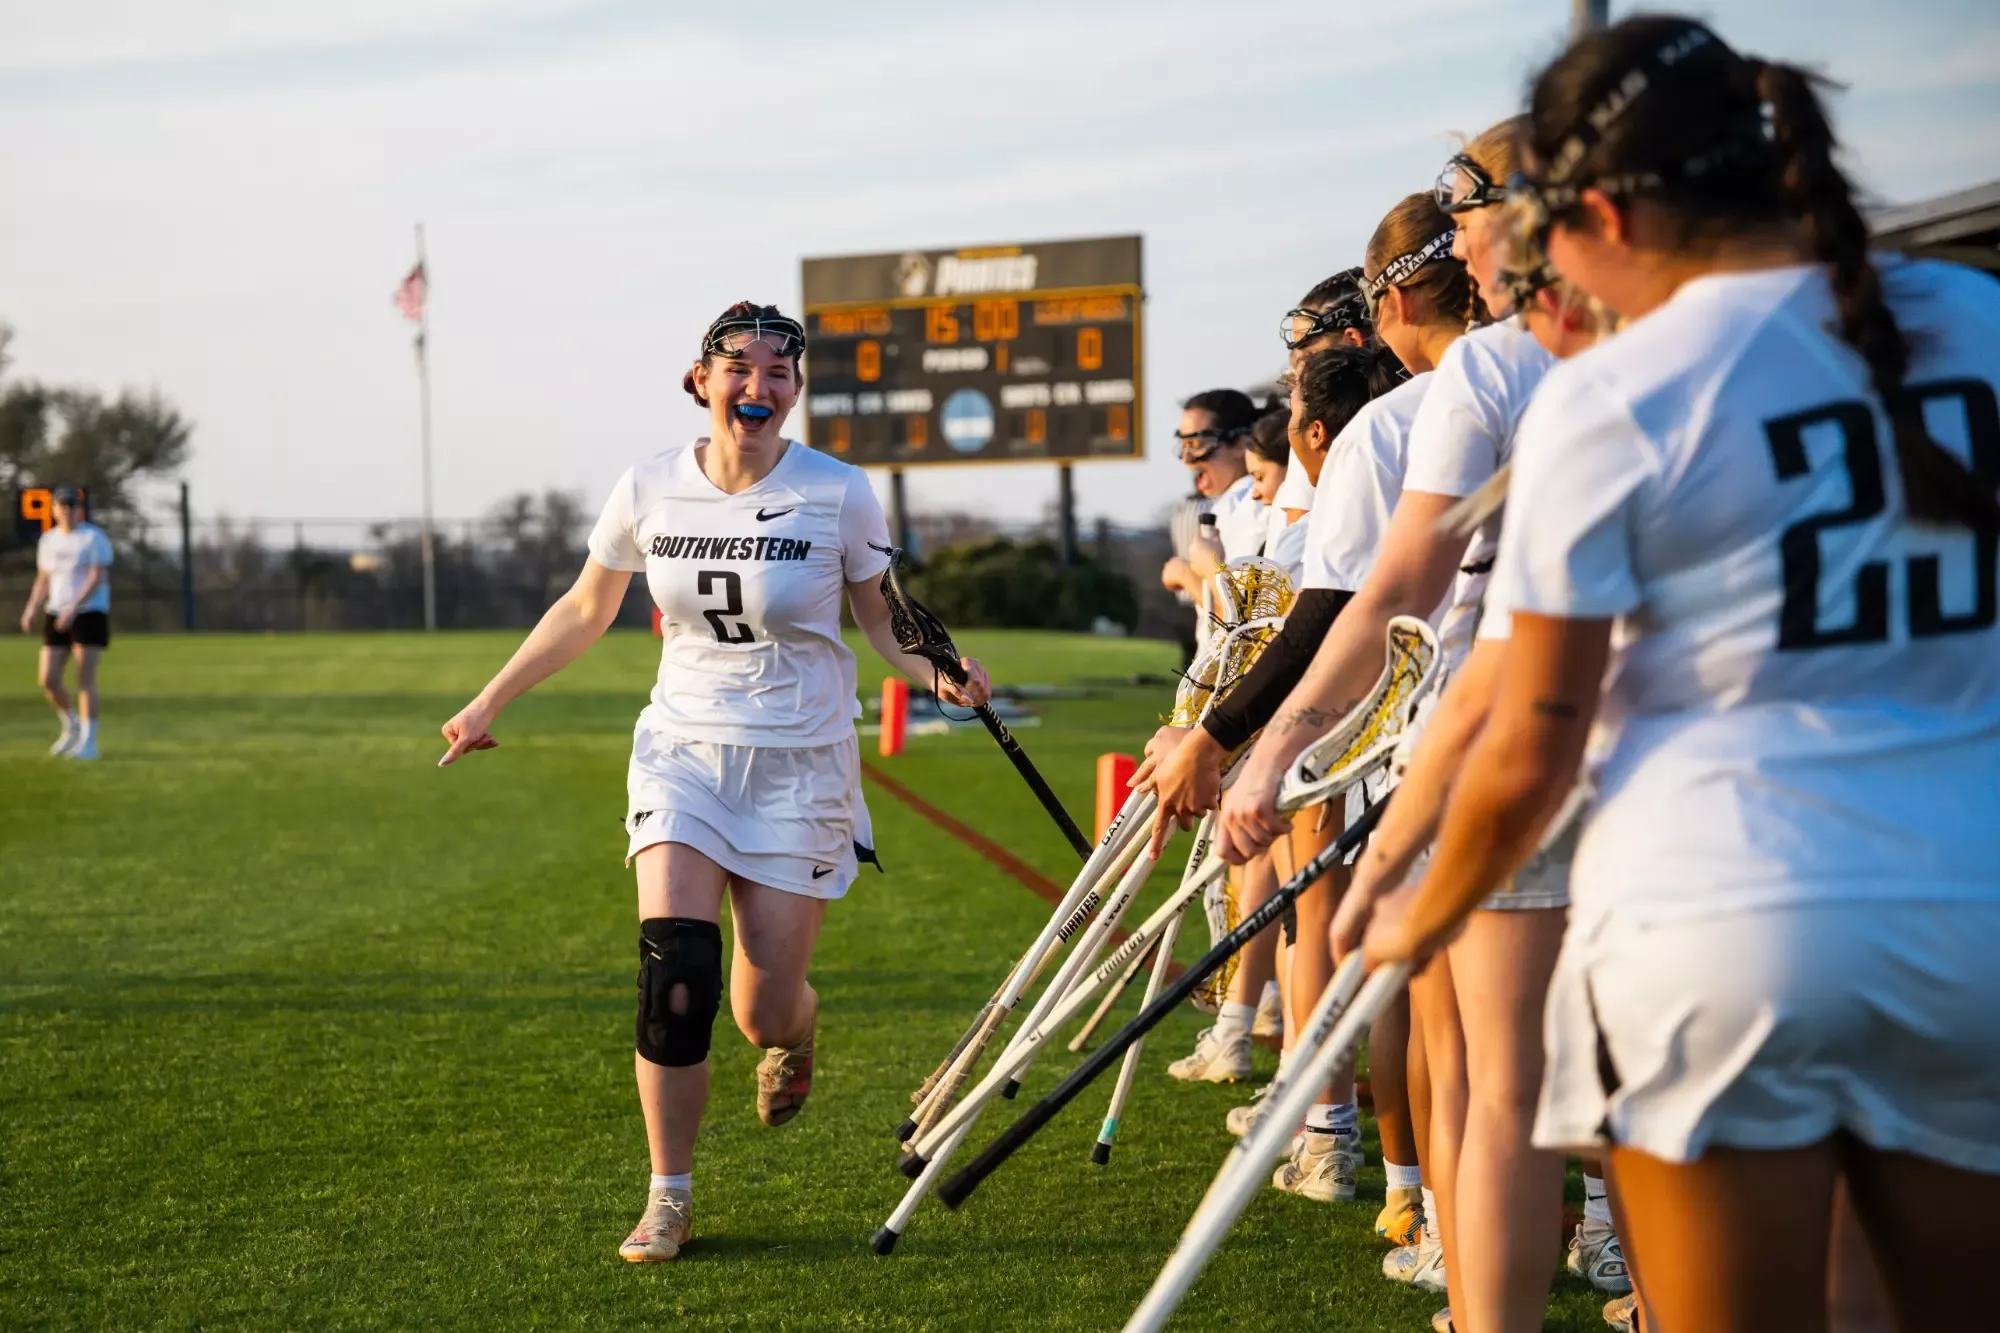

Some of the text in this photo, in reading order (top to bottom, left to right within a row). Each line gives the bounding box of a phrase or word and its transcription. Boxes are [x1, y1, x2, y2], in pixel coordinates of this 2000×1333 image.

[1386, 254, 1413, 277] GAIT
[651, 535, 812, 561] SOUTHWESTERN
[697, 570, 756, 644] 2
[1101, 811, 1125, 846] GAIT
[1192, 839, 1212, 872] GAIT
[1057, 890, 1101, 944] PIRATES
